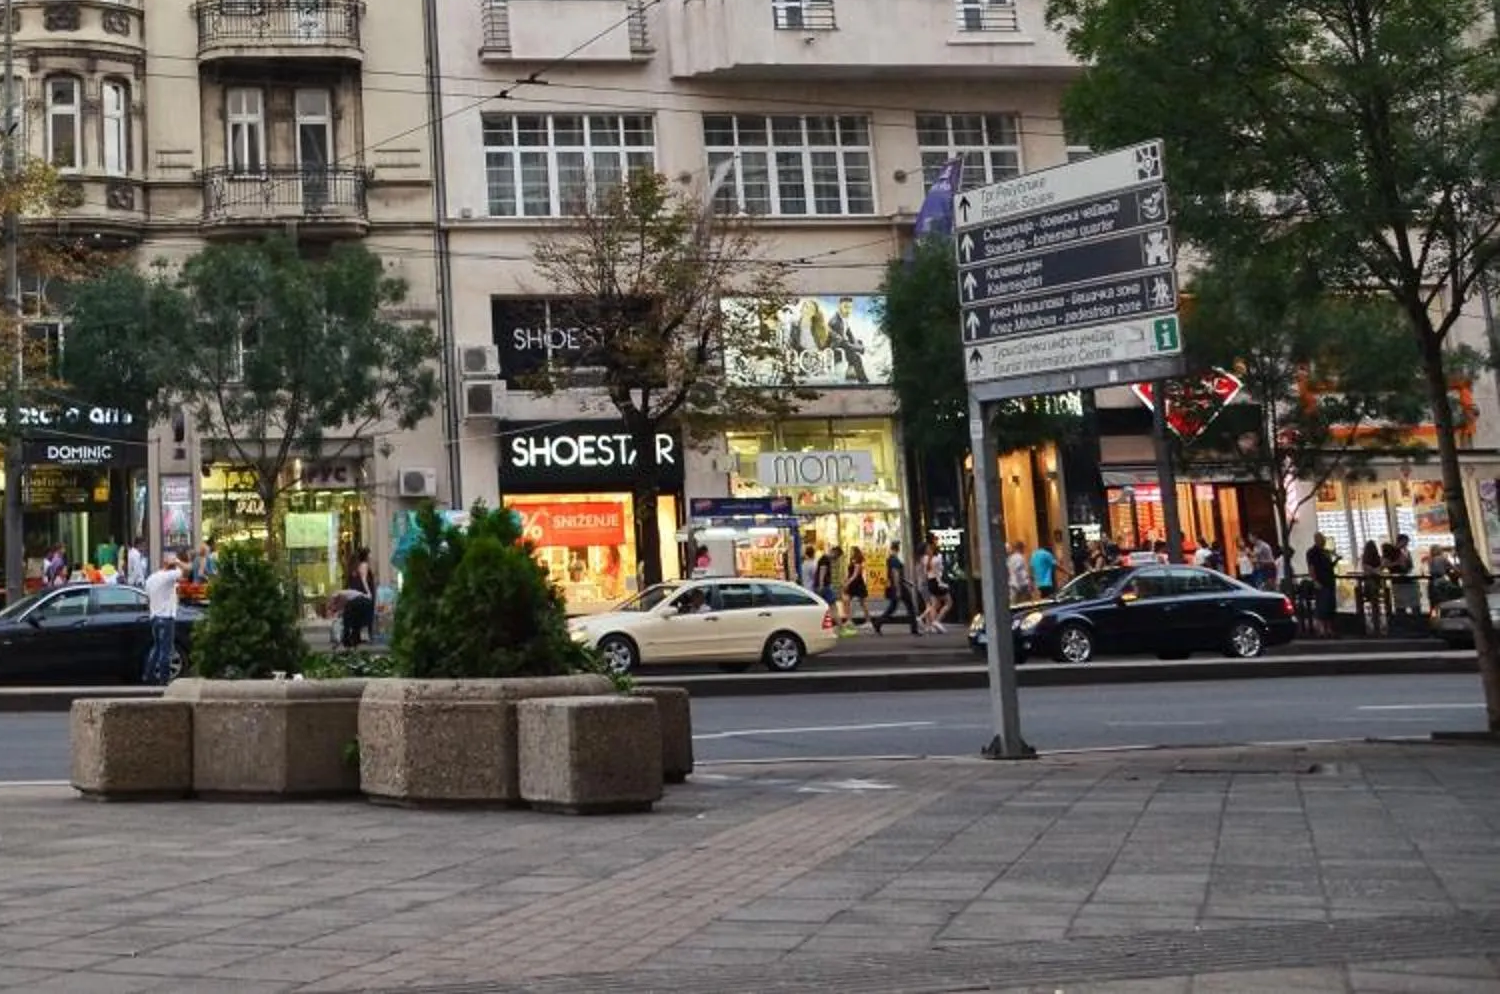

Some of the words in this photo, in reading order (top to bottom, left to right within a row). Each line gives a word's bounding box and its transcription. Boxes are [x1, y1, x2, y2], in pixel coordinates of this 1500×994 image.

[47, 446, 112, 459] DOMINIC
[511, 433, 675, 467] SHOESTR
[552, 512, 620, 530] SNIŽENJE
